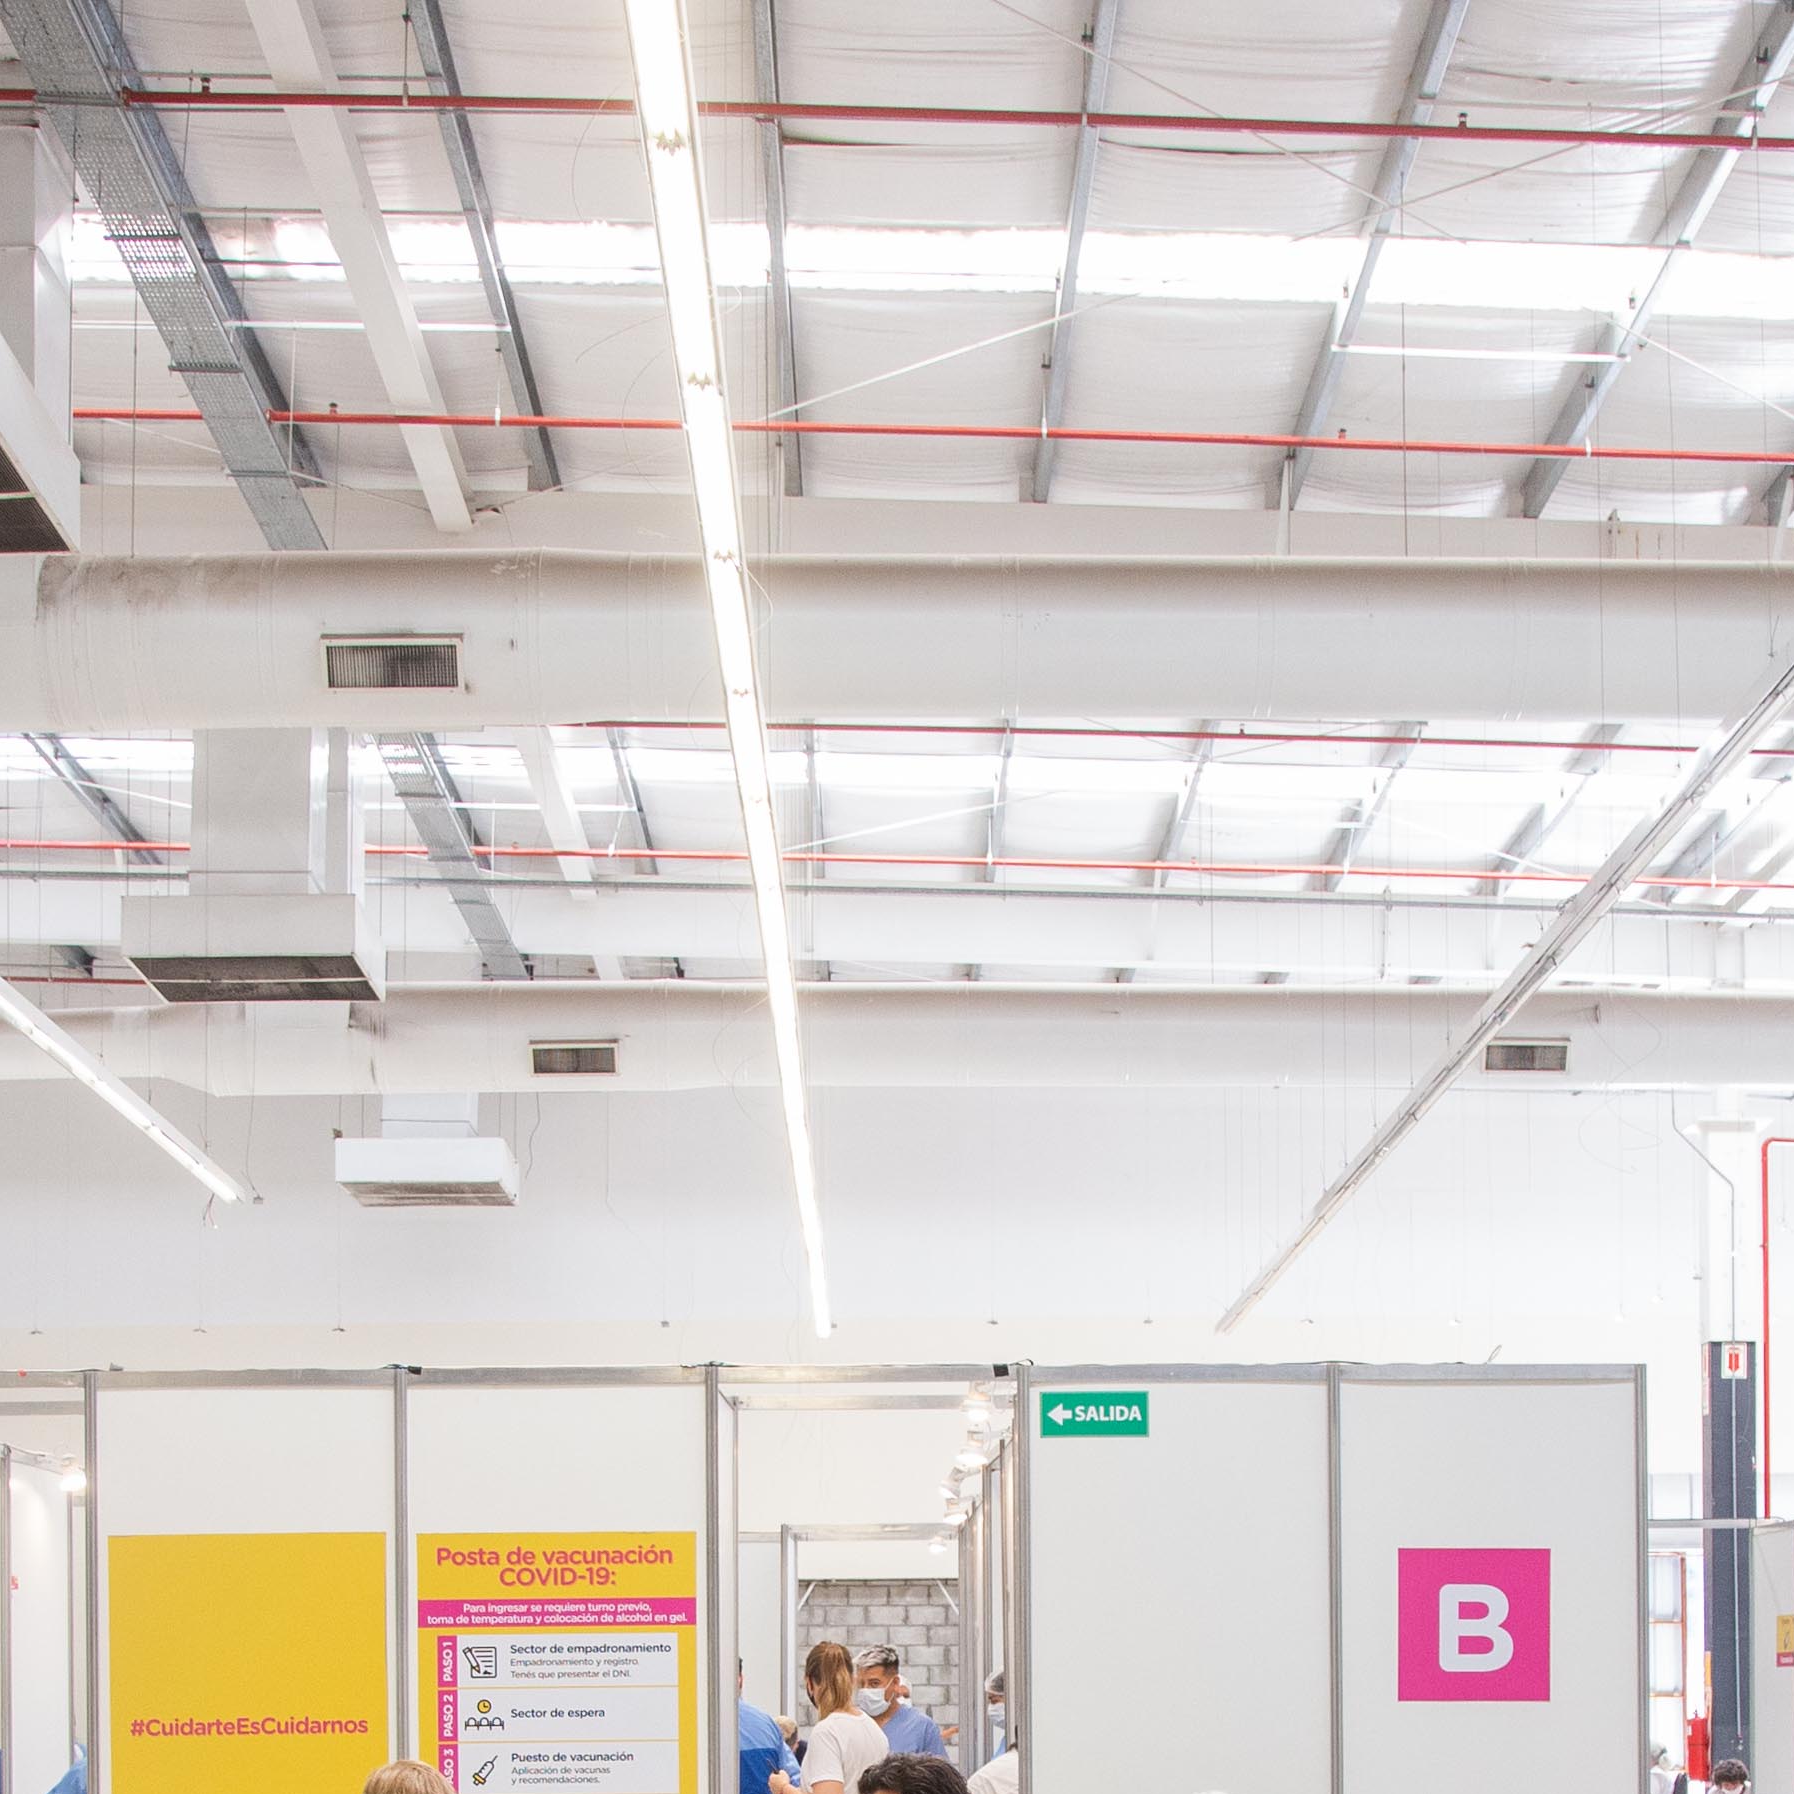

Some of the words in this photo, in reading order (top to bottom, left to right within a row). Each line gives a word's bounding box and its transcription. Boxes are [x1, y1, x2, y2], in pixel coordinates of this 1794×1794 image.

[1075, 1405, 1142, 1423] SALIDA
[437, 1547, 499, 1566] Posta
[507, 1546, 535, 1566] de
[542, 1544, 673, 1565] vacunación
[499, 1567, 616, 1587] COVID-19:
[463, 1603, 486, 1613] Para
[488, 1603, 528, 1615] ingresar
[530, 1605, 542, 1613] se
[544, 1603, 585, 1615] requiere
[588, 1603, 616, 1612] turno
[617, 1603, 652, 1614] previo,
[427, 1616, 454, 1625] toma
[456, 1615, 470, 1624] de
[472, 1615, 533, 1626] temperatura
[535, 1616, 542, 1626] y
[544, 1613, 598, 1624] colocación
[601, 1614, 614, 1623] de
[616, 1613, 652, 1622] alcohol
[670, 1613, 687, 1624] gel.
[1439, 1584, 1513, 1673] B
[511, 1644, 546, 1655] Sector
[550, 1644, 565, 1654] de
[567, 1643, 672, 1656] empadronamiento
[443, 1650, 453, 1682] PASO
[511, 1658, 594, 1668] Empadronamiento
[604, 1657, 639, 1668] registro.
[511, 1669, 537, 1679] Tenés
[539, 1671, 556, 1681] que
[558, 1670, 598, 1680] presentar
[600, 1669, 610, 1678] el
[612, 1669, 631, 1678] DNI.
[443, 1695, 454, 1704] 2
[511, 1708, 547, 1718] Sector
[551, 1708, 565, 1718] de
[568, 1709, 605, 1720] espera
[131, 1717, 368, 1737] #CuidarteEsCuidarnos
[443, 1706, 454, 1737] PASO
[443, 1749, 454, 1757] 3
[512, 1753, 550, 1763] Puesto
[553, 1753, 567, 1762] de
[569, 1751, 634, 1762] vacunación
[444, 1759, 454, 1785] ASO
[512, 1766, 559, 1777] Aplicación
[560, 1767, 571, 1775] de
[573, 1767, 611, 1775] vacunas
[519, 1776, 600, 1784] recomendaciones.
